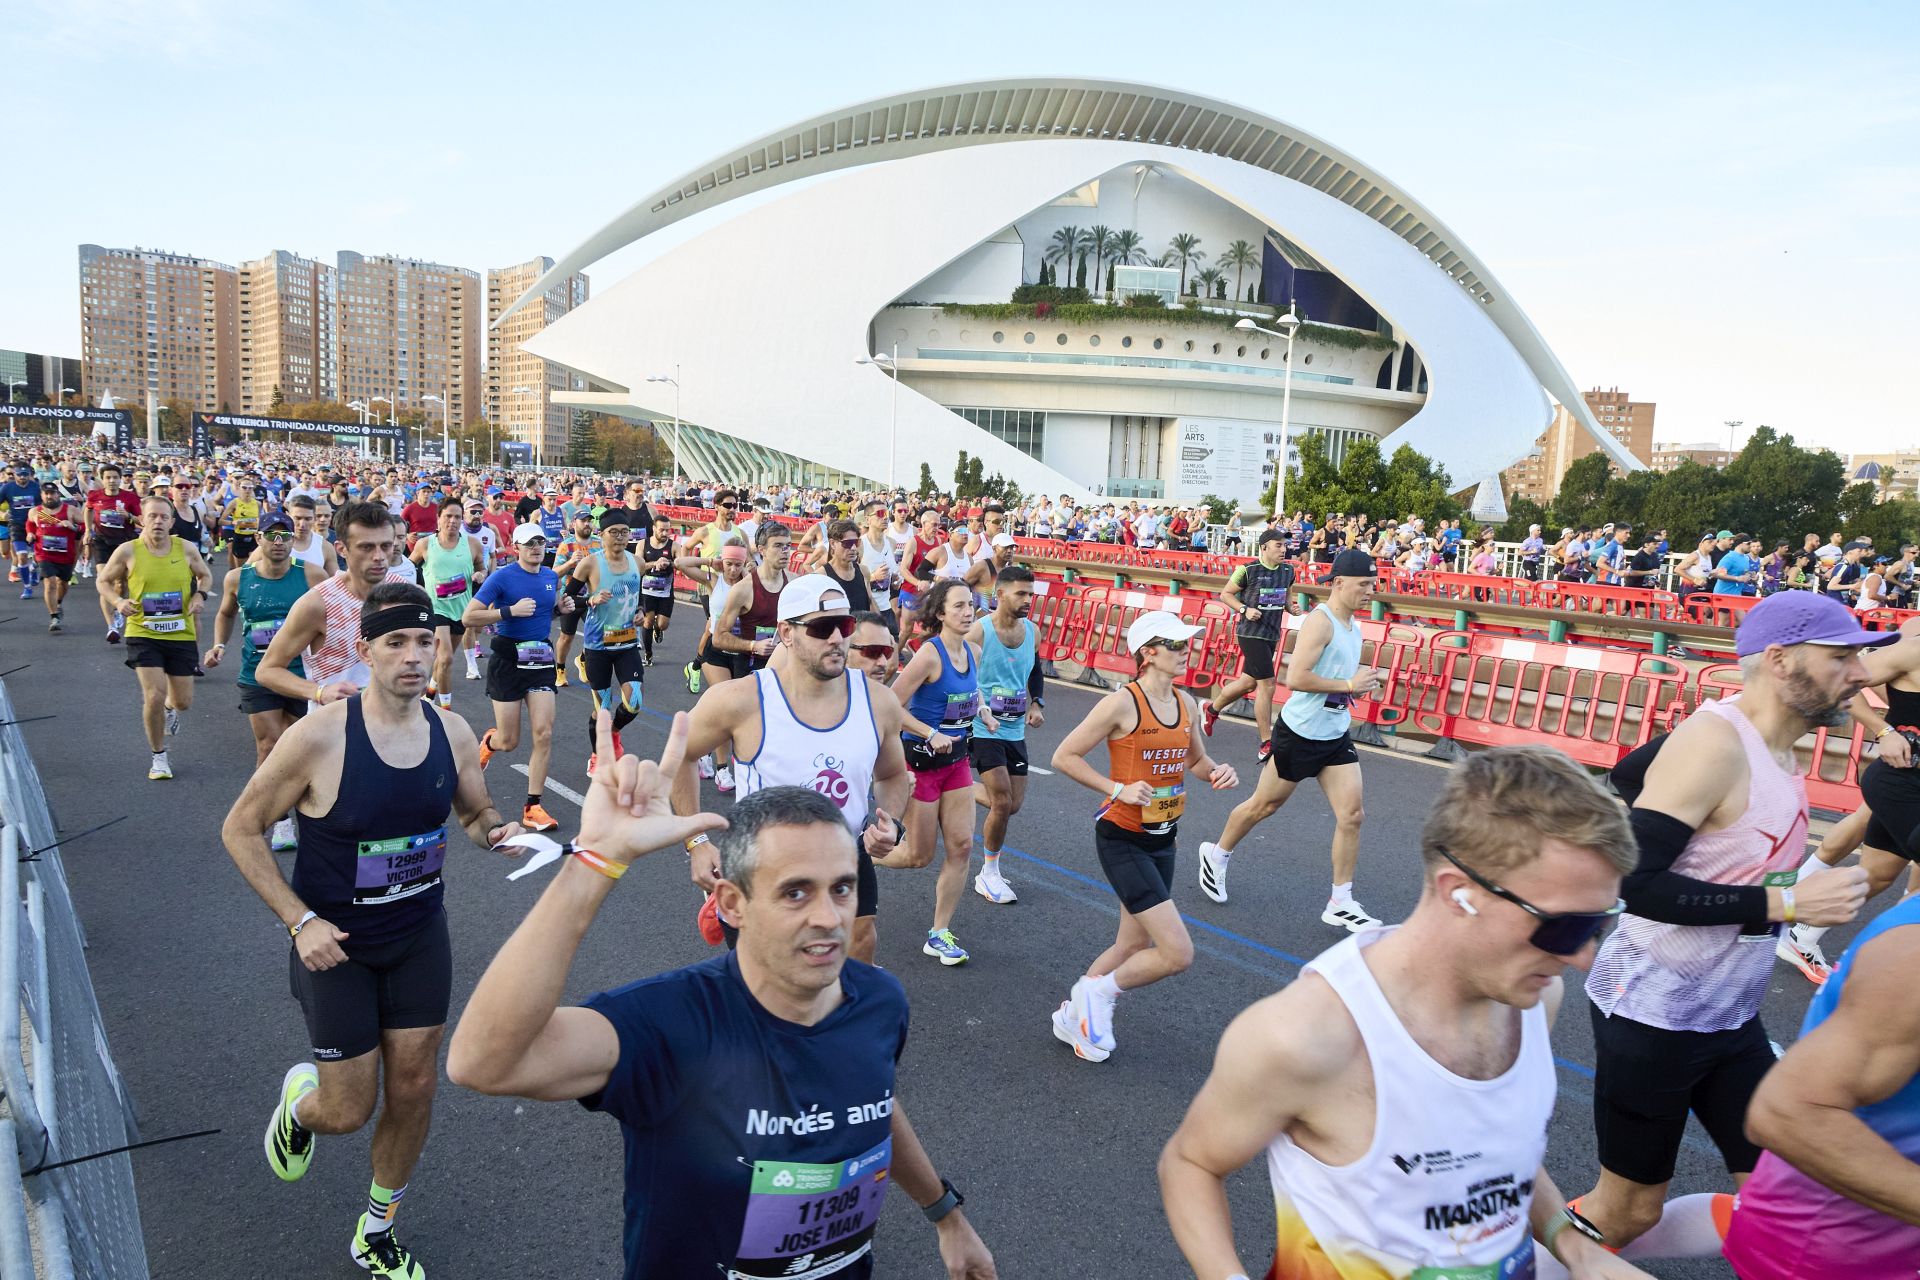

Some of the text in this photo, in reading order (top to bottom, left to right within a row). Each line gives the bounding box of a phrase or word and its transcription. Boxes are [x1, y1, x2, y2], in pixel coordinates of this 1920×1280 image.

[18, 407, 72, 418] ALFONSO
[214, 416, 360, 434] 42K VALENCIA TRINIDAD ALFONSO
[1185, 424, 1199, 432] LES
[1185, 433, 1205, 441] ARTS
[154, 622, 179, 630] PHILIP
[425, 833, 441, 843] ZURIC
[386, 850, 427, 868] 12999
[386, 866, 424, 883] VICTOR
[1677, 893, 1740, 906] RYZON
[746, 1103, 835, 1136] Nordés
[798, 1185, 860, 1225] 11309
[774, 1225, 822, 1254] JOSE
